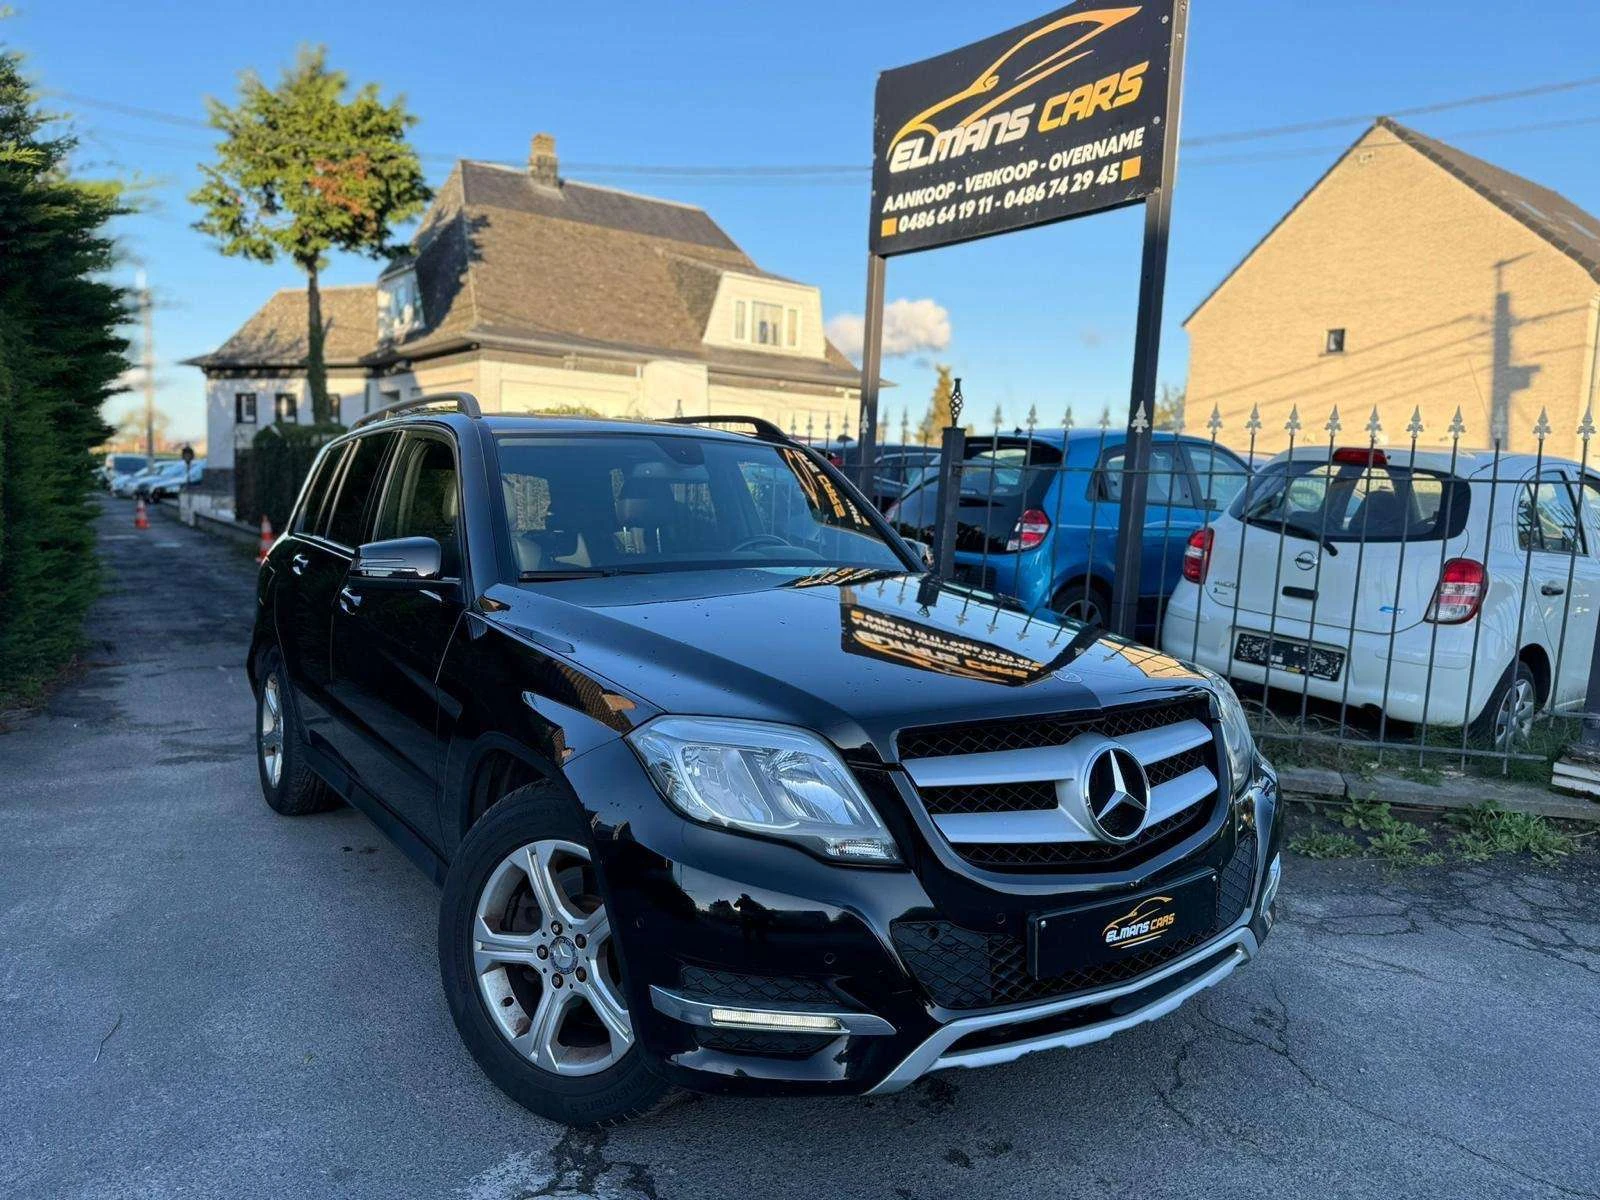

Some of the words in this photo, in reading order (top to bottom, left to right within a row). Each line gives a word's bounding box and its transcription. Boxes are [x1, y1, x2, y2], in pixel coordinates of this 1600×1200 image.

[889, 103, 1036, 174] ELMANS
[1037, 61, 1149, 133] CARS
[882, 181, 956, 213] AANKOOP
[965, 160, 1038, 194] VERKOOP
[1048, 126, 1145, 172] OVERNAME
[899, 209, 936, 233] 0486
[937, 204, 956, 224] 64
[958, 200, 976, 220] 19
[978, 194, 994, 215] 11
[1003, 182, 1046, 209] 0486
[1047, 176, 1069, 199] 74
[1070, 170, 1094, 194] 29
[1095, 162, 1121, 185] 45
[1105, 920, 1150, 943] ELMANS
[1150, 912, 1175, 931] CARS
